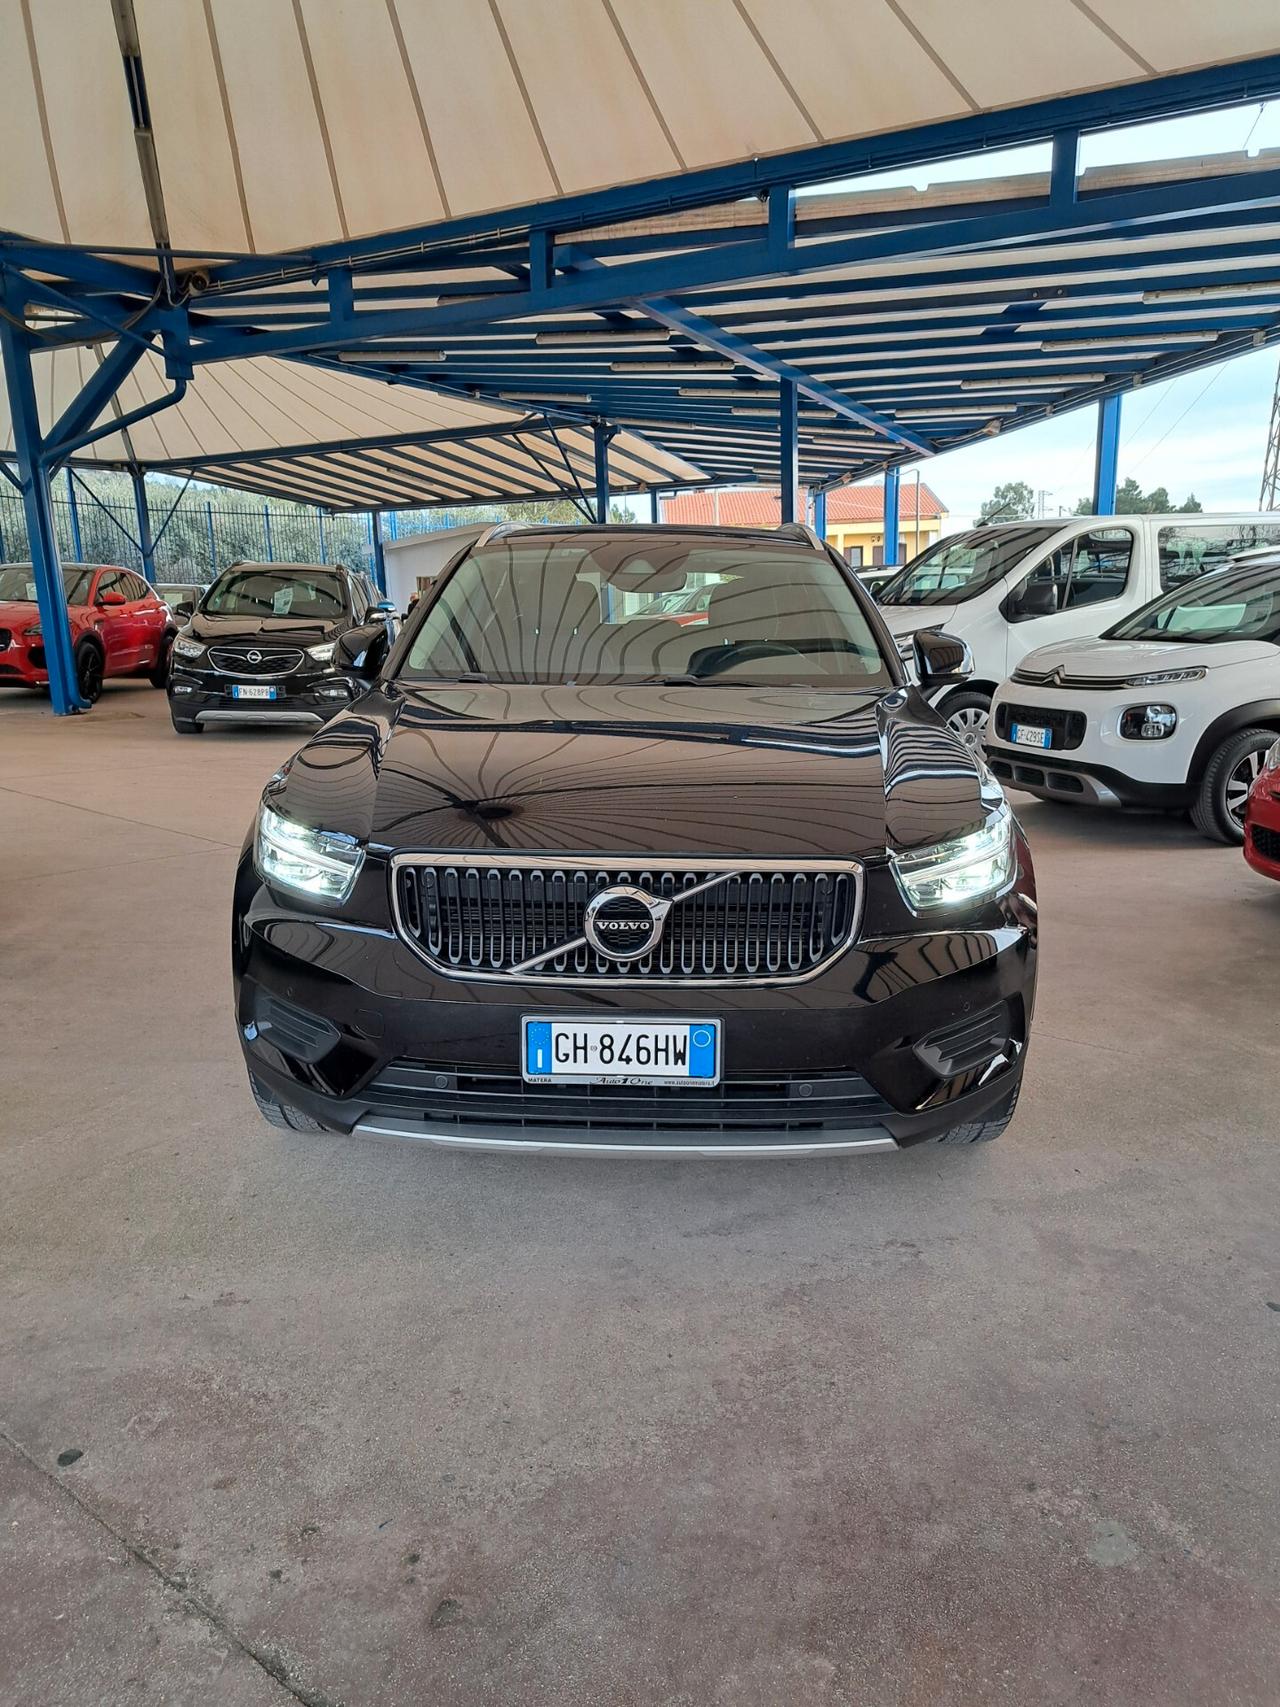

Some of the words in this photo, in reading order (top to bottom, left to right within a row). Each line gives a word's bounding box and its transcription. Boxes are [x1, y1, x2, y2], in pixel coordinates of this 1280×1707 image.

[596, 921, 650, 930] VOLVO
[555, 1032, 588, 1064] GH
[599, 1033, 688, 1066] 846HW
